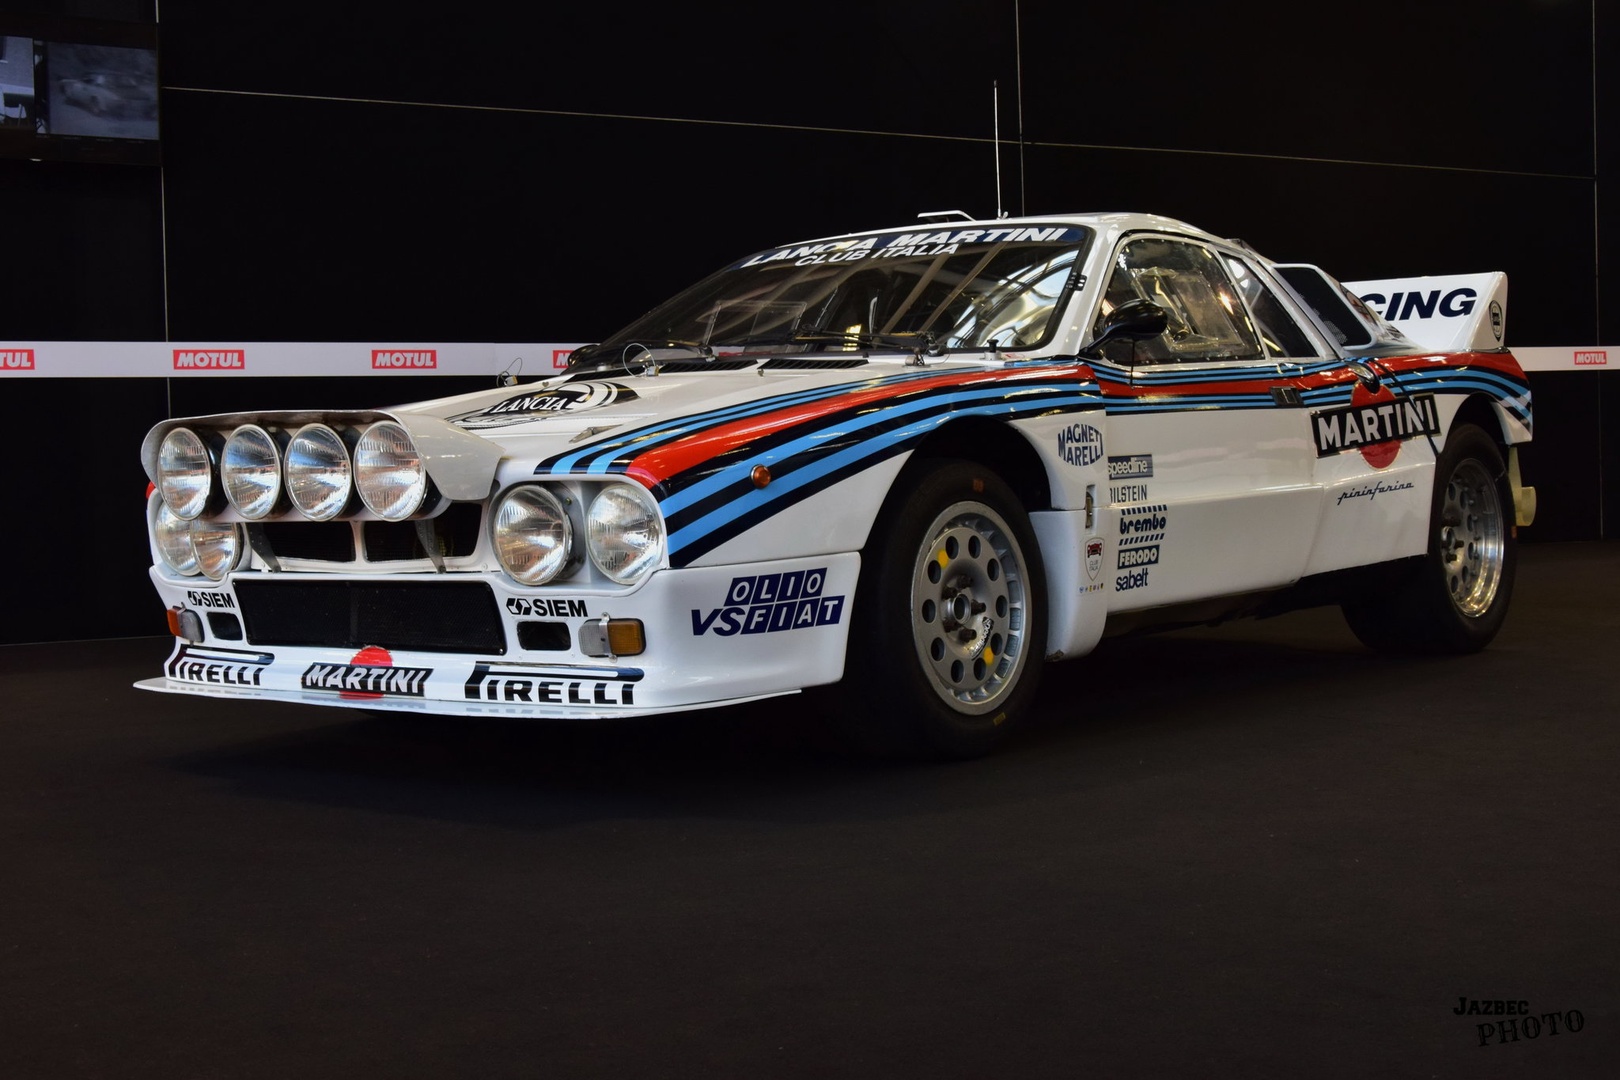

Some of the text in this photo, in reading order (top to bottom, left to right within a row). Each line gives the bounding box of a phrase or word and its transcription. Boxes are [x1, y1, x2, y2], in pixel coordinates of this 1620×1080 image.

[887, 228, 1069, 248] MARTINI
[795, 243, 960, 267] CLUB ITALIA
[177, 352, 242, 368] MOTUL
[374, 352, 434, 367] MOTUL
[1576, 353, 1606, 364] MOTUL
[490, 397, 569, 414] LANCIA
[1058, 423, 1103, 446] MAGNETI
[1318, 399, 1435, 450] MARTINI
[1058, 443, 1104, 467] MARELLI
[1108, 457, 1149, 478] speedline
[1337, 481, 1415, 505] pininfarina
[1120, 514, 1167, 535] brembo
[1119, 547, 1158, 567] FERODO
[730, 571, 823, 603] OLIO
[1115, 567, 1149, 592] sabelt
[201, 592, 236, 608] SIEM
[532, 599, 588, 617] SIEM
[691, 600, 840, 636] VS FIAT
[164, 643, 275, 686] PIRELLI
[305, 664, 428, 694] MARTINI
[464, 661, 645, 705] PIRELLI
